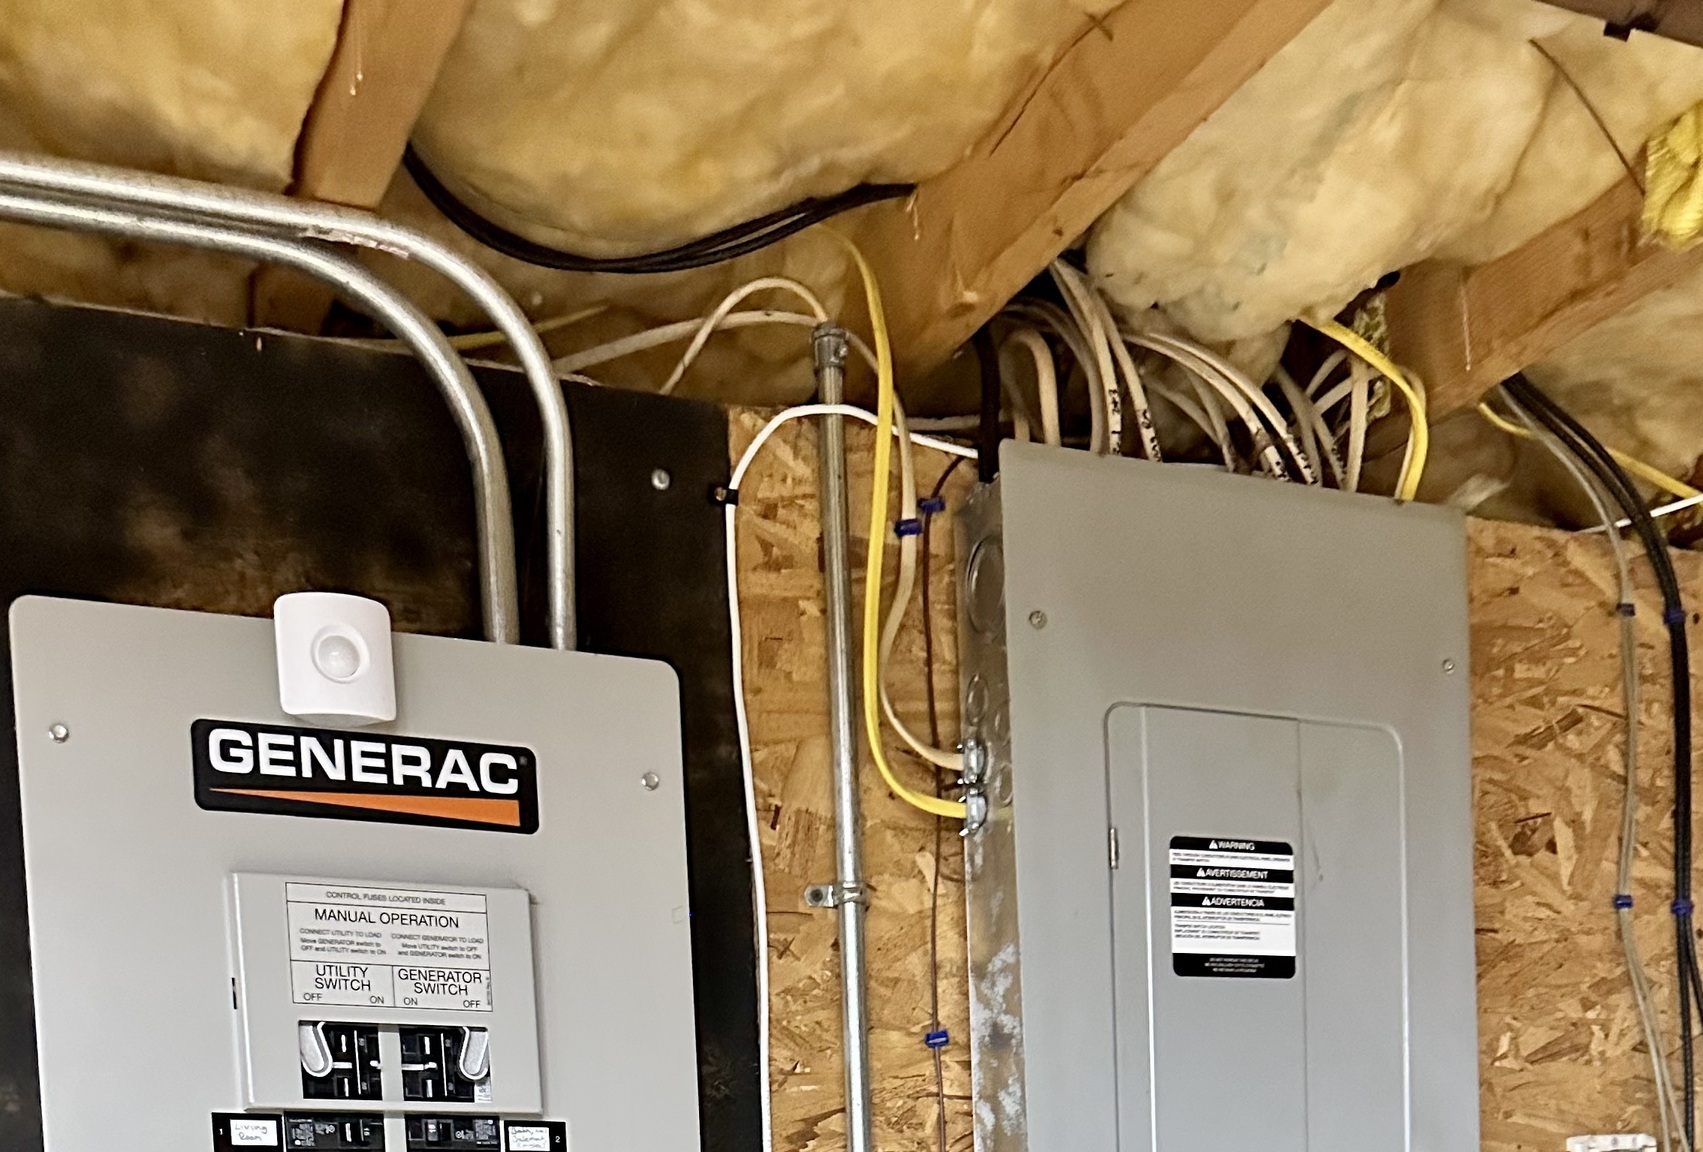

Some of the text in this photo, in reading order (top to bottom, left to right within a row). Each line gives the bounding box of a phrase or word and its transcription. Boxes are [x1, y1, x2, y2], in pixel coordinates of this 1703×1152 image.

[208, 728, 519, 794] GENERAC
[1218, 841, 1255, 850] WARNING
[1206, 869, 1268, 879] AVERTISSEMENT
[326, 891, 361, 900] CONTROL
[389, 895, 421, 903] LOCATED
[1210, 897, 1264, 907] ADVERTENCIA
[315, 908, 459, 928] MANUAL OPERATION
[316, 964, 368, 978] UTILITY
[398, 969, 482, 983] GENERATOR
[315, 977, 370, 991] SWITCH
[414, 982, 468, 995] SWITCH
[303, 993, 322, 1001] OFF
[370, 996, 384, 1004] ON
[404, 997, 418, 1005] ON
[463, 1000, 480, 1008] OFF
[235, 1123, 268, 1134] Living
[240, 1132, 262, 1140] Room
